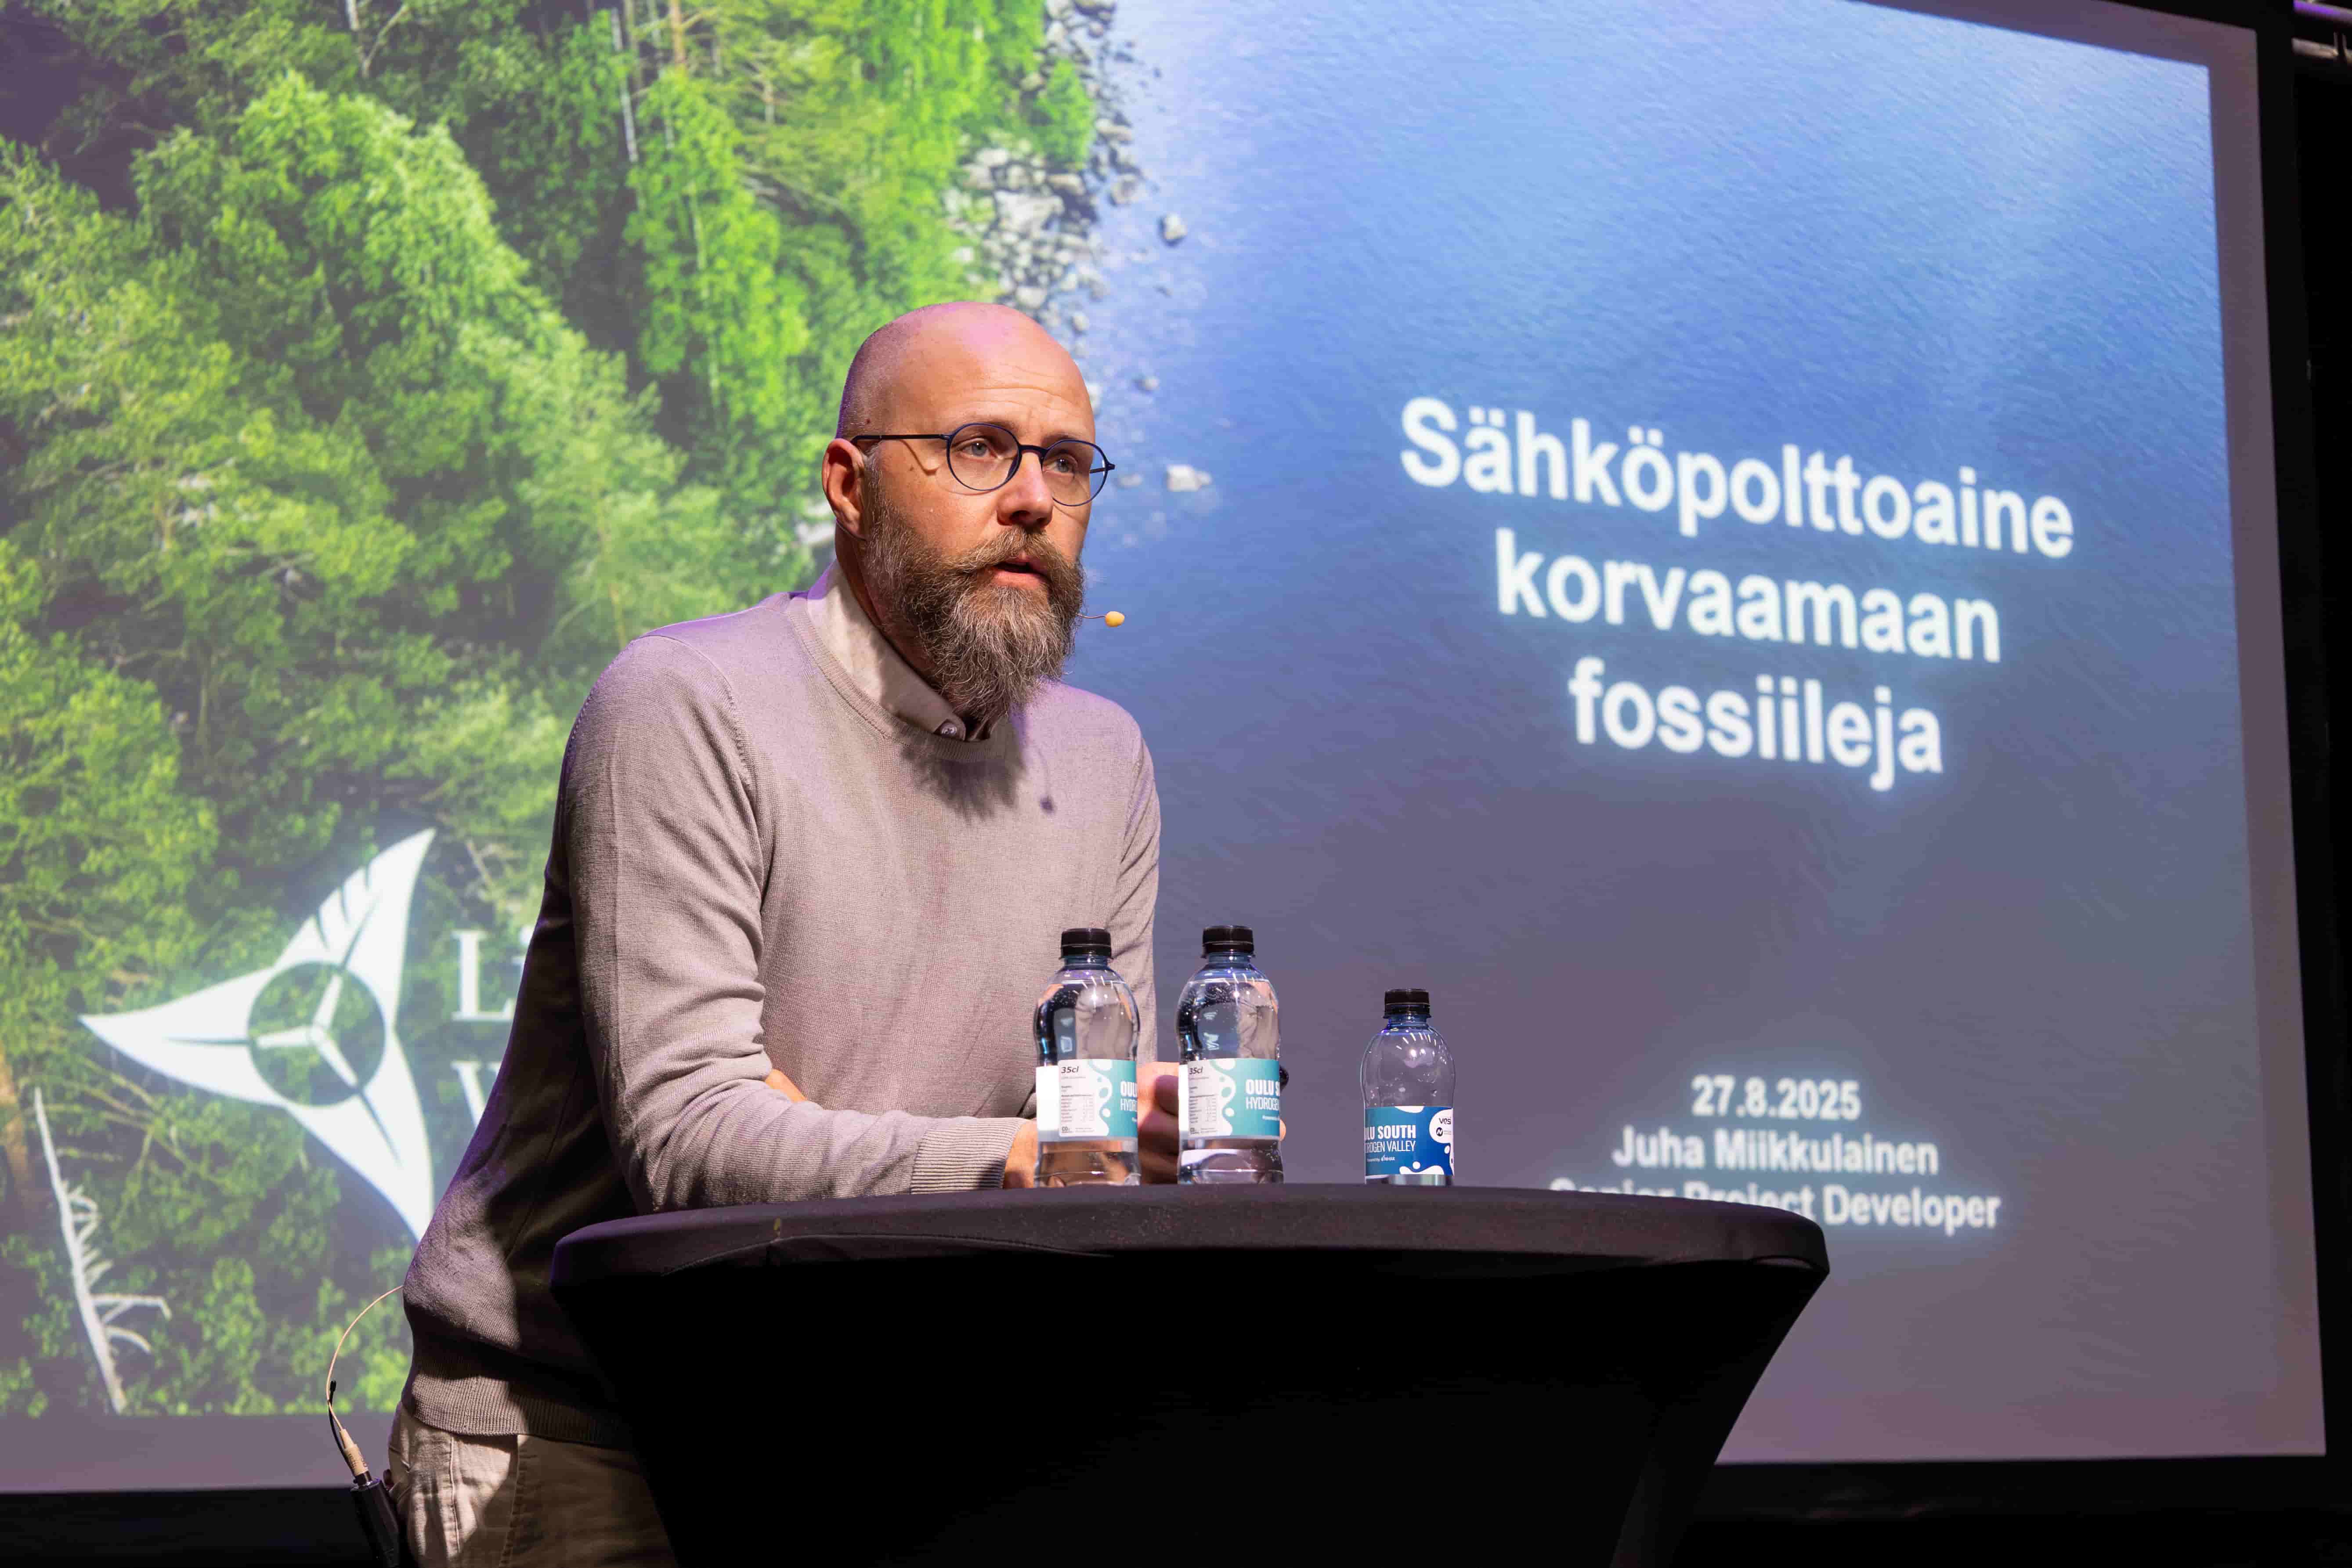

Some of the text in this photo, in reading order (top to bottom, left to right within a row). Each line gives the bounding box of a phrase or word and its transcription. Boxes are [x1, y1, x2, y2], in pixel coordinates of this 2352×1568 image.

[1400, 397, 2074, 558] Sähköpolttoaine
[1495, 528, 2001, 662] korvaamaan
[1568, 657, 1943, 791] fossiileja
[1189, 1066, 1203, 1075] 35cl
[1246, 1079, 1274, 1096] OULU
[1692, 1075, 1861, 1121] 27.8.2025
[1377, 1124, 1416, 1139] SOUTH
[1387, 1140, 1416, 1153] VALLEY
[1612, 1126, 1939, 1175] Juha Miikkulainen
[1822, 1184, 2001, 1236] Developer
